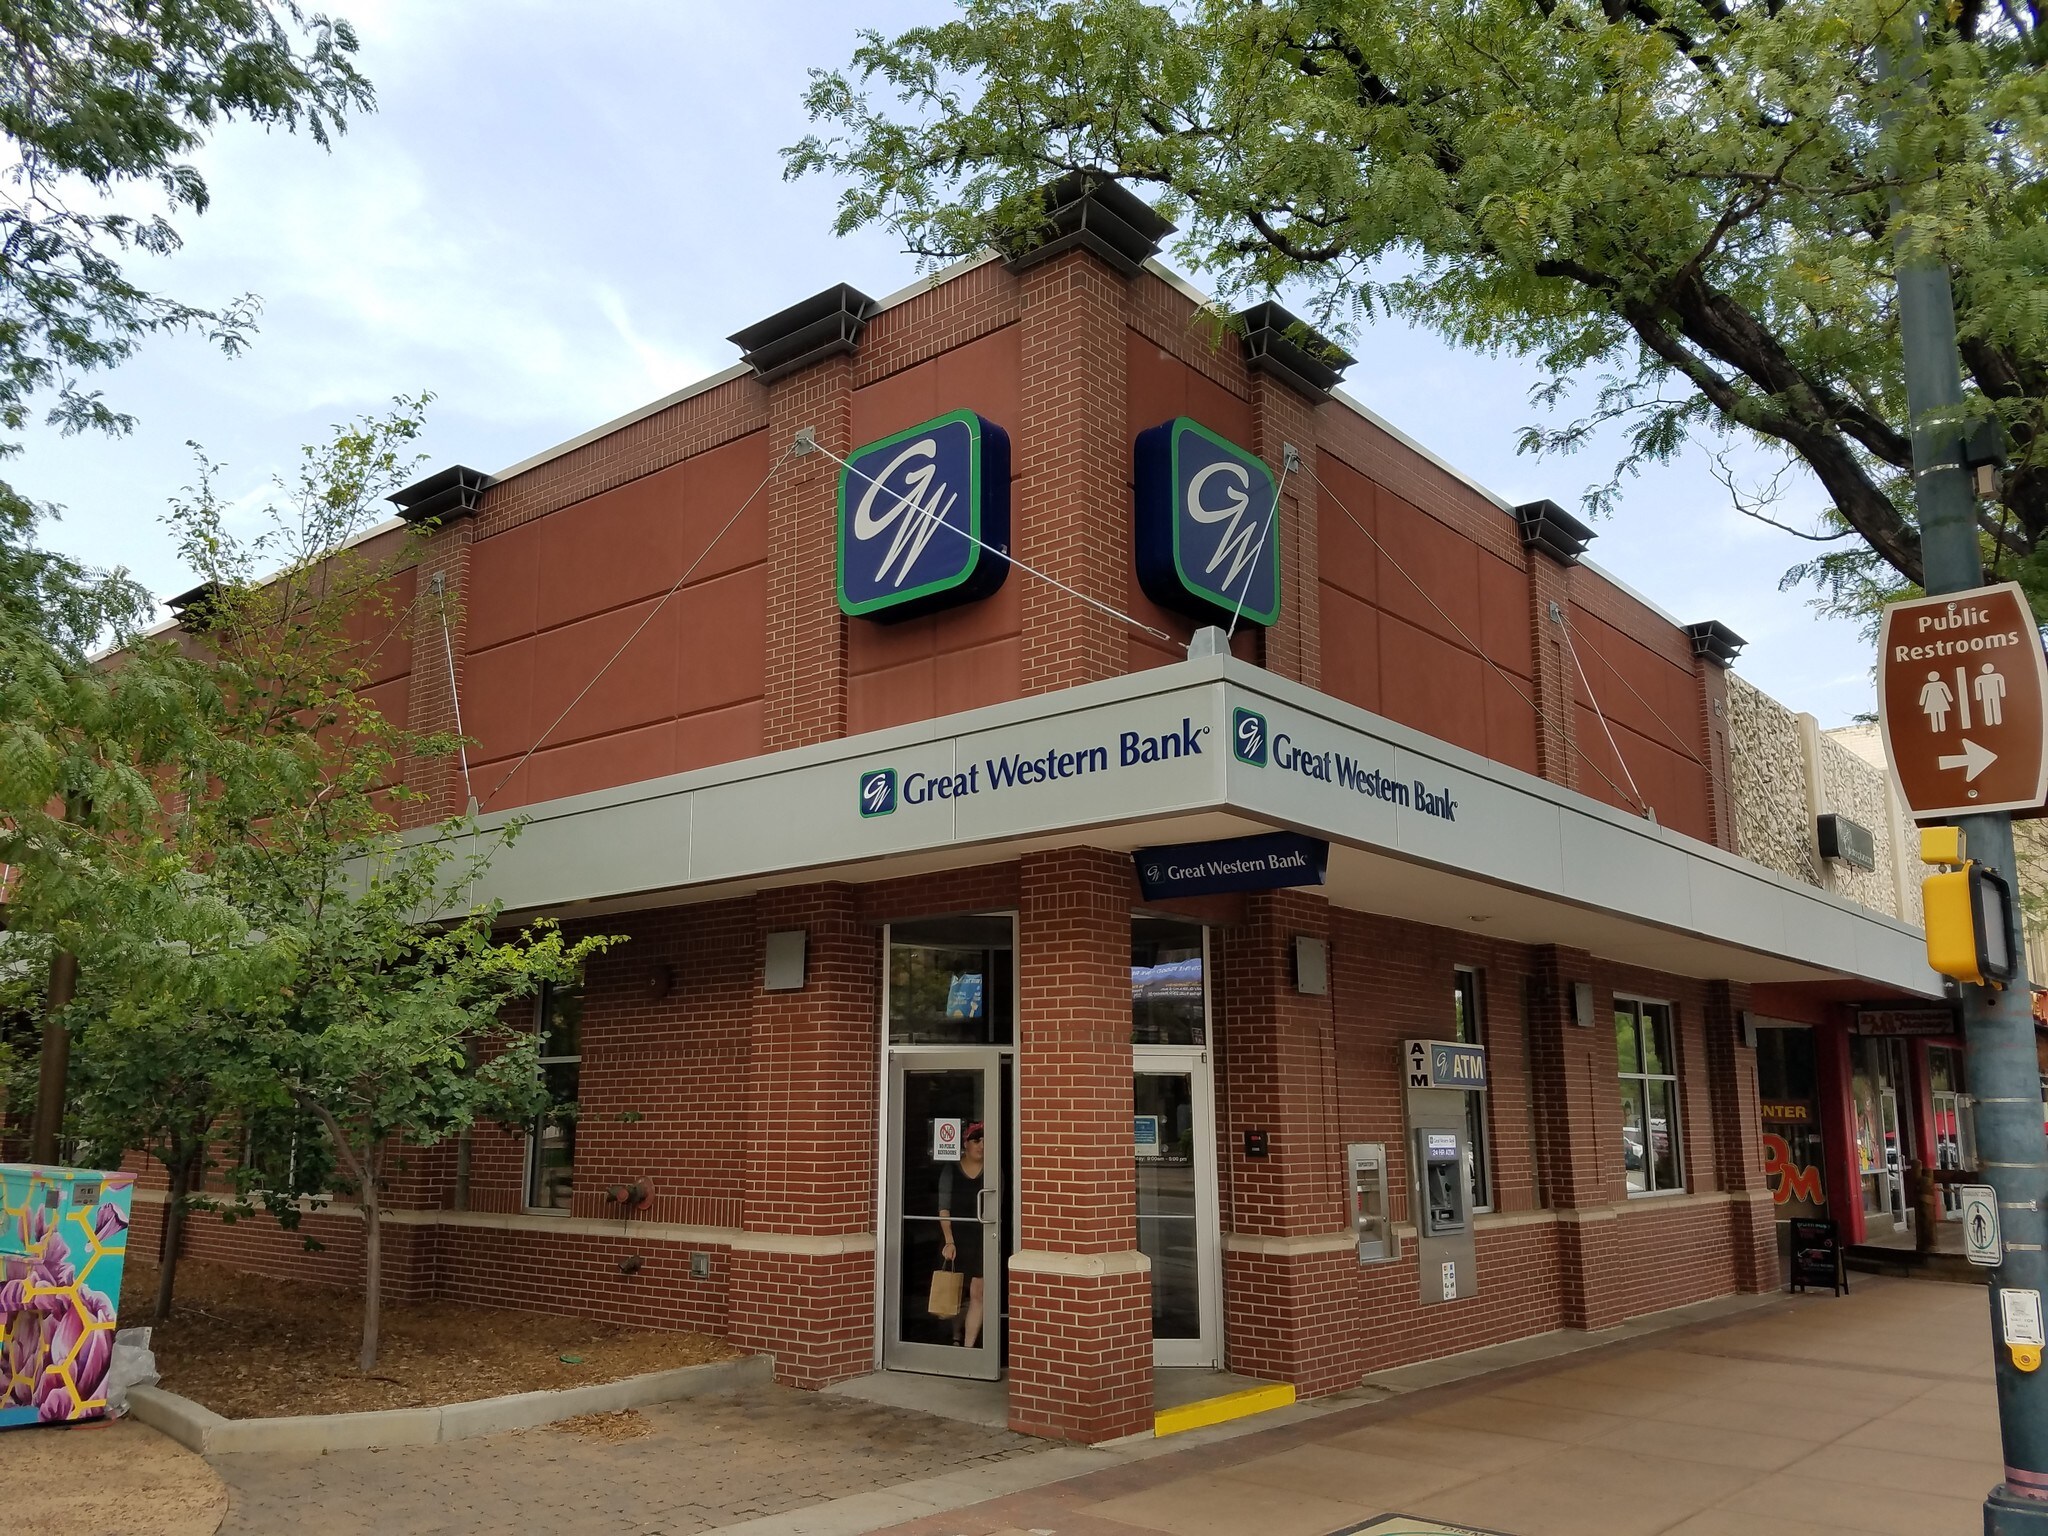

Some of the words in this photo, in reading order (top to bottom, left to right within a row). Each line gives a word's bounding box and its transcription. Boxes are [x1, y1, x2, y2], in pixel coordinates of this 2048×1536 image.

[1918, 606, 1990, 633] Public
[1895, 631, 2019, 663] Restrooms
[903, 763, 979, 805] Great
[985, 746, 1108, 790] Western
[1272, 733, 1332, 783] Great
[1335, 753, 1410, 807] Western
[1167, 863, 1207, 880] Great
[1207, 858, 1266, 876] Western
[1268, 850, 1307, 869] Bank
[1453, 1054, 1484, 1079] ATM
